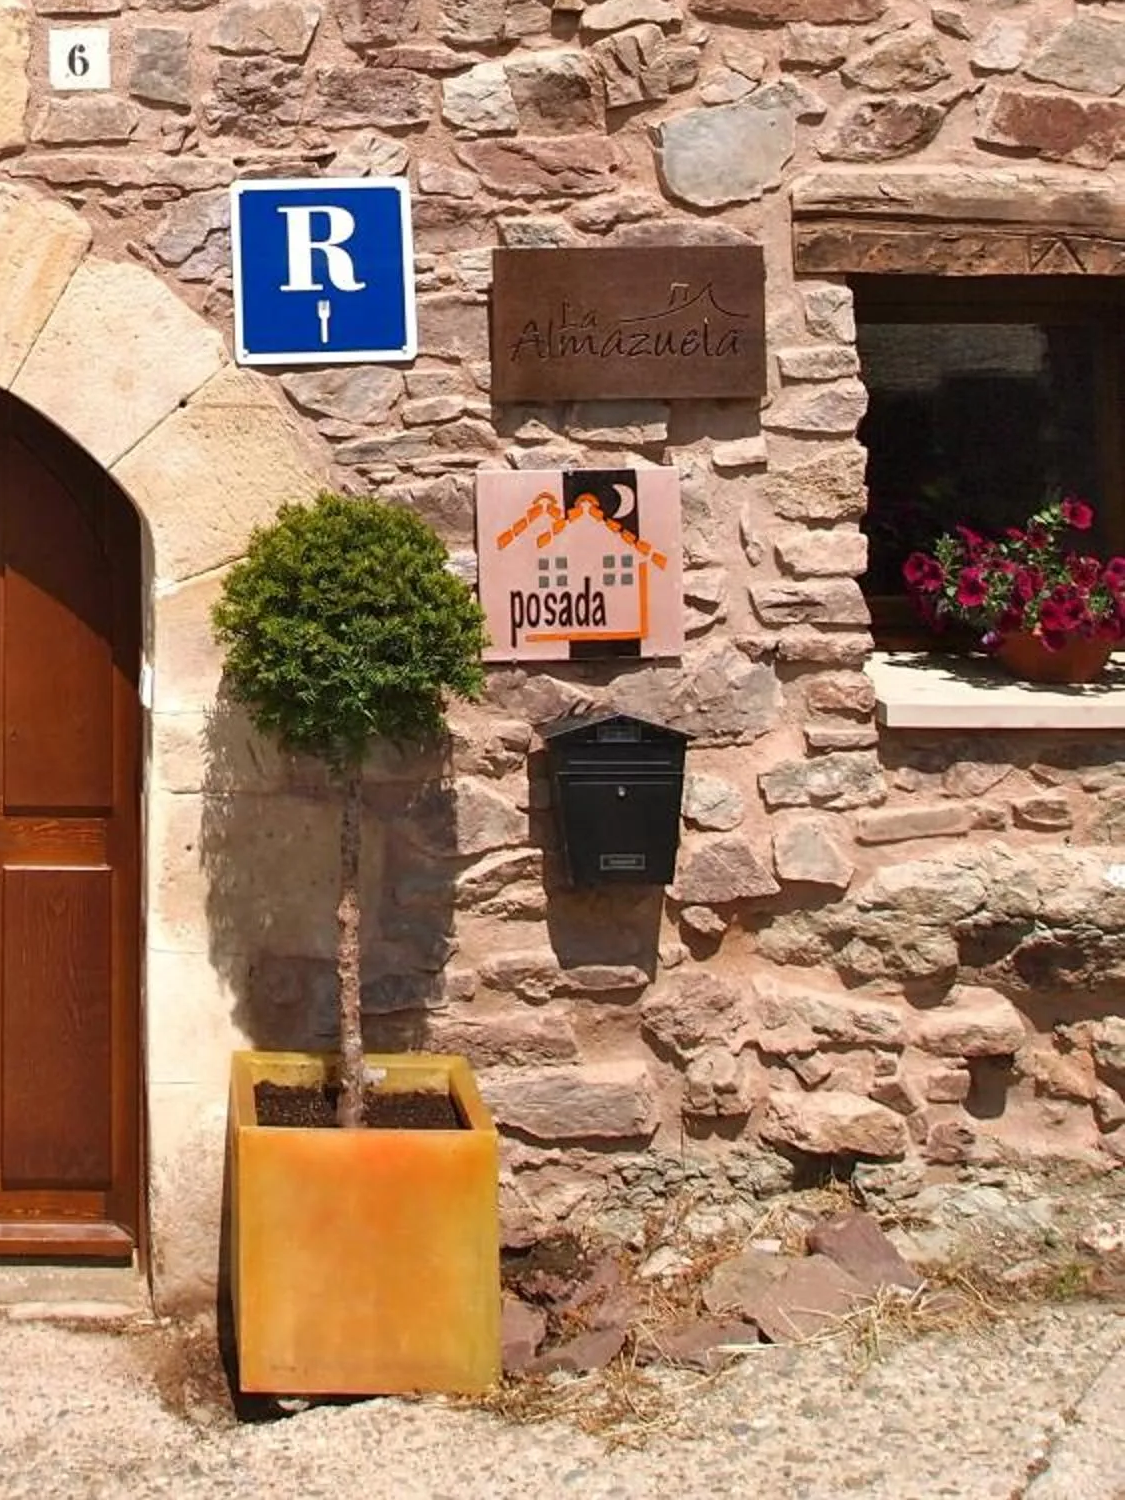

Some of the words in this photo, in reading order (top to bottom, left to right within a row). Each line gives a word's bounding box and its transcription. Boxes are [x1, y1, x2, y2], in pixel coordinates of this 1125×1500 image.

[67, 43, 90, 77] 6
[277, 205, 367, 292] R
[558, 298, 598, 331] La
[510, 317, 742, 362] Almazuela
[510, 576, 607, 648] posada
